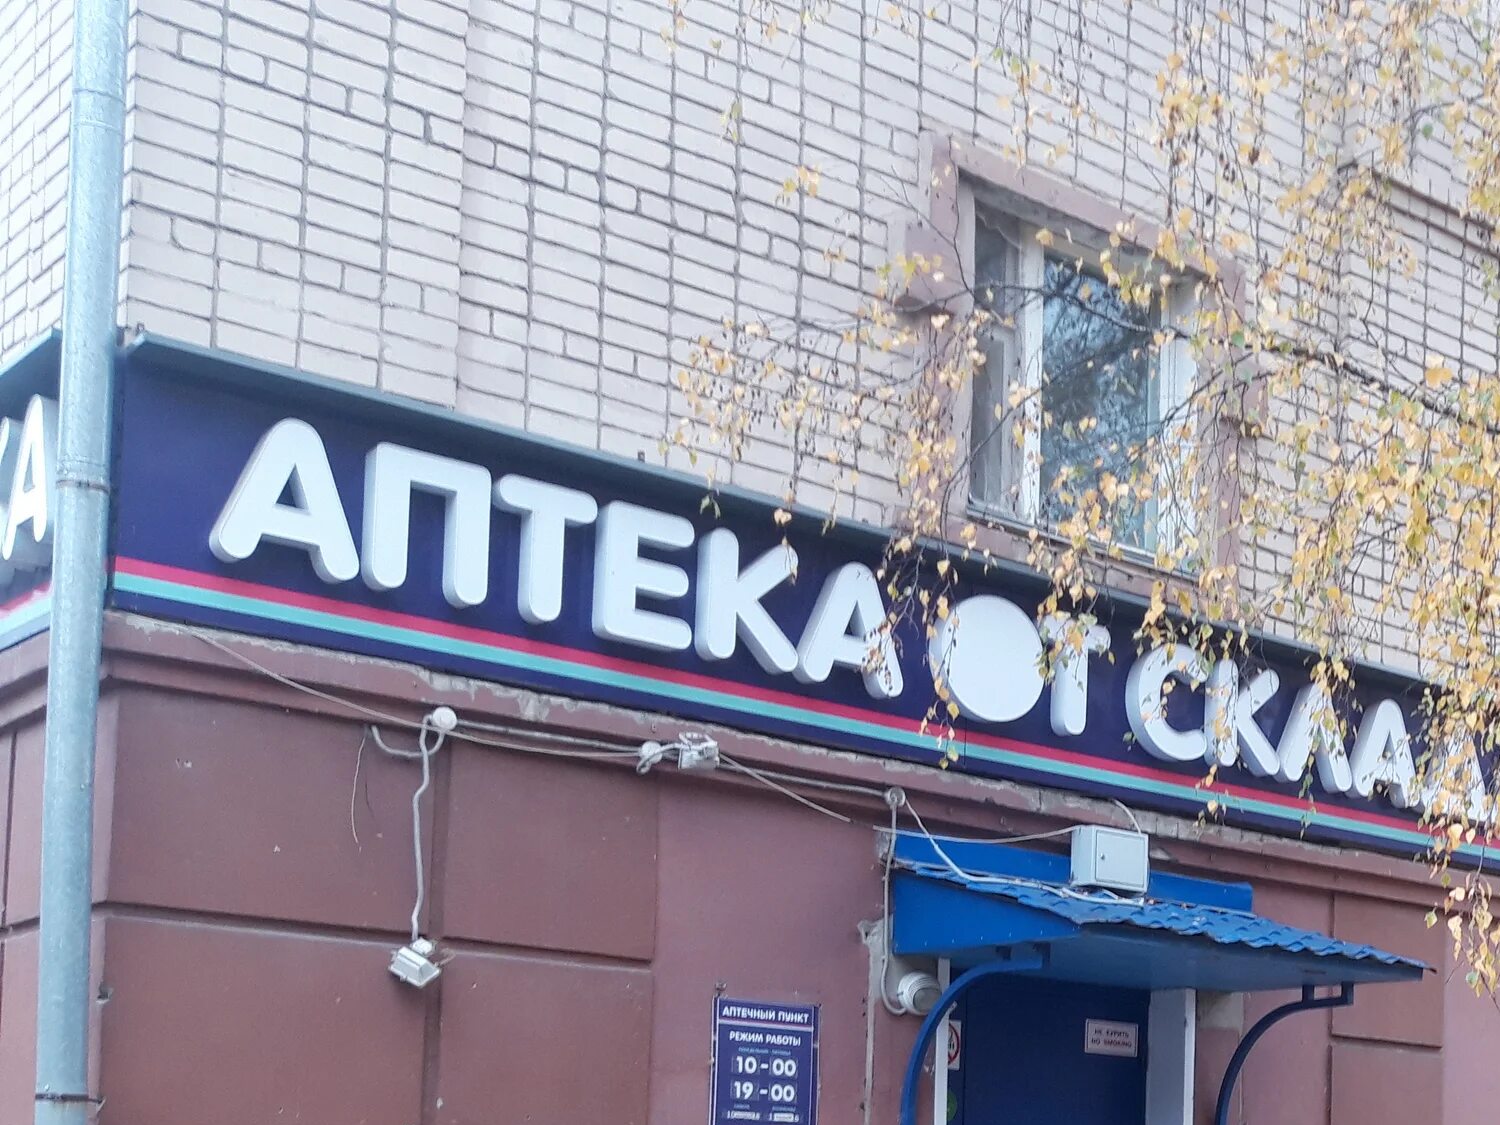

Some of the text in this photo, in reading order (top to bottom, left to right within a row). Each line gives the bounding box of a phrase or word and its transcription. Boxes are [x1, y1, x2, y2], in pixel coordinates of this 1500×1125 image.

[209, 417, 903, 700] АПТЕКА
[722, 1006, 809, 1024] АПТЕЧНЫЙ ПУНКТ
[729, 1030, 801, 1047] РЕЖИМ РАБОТЫ
